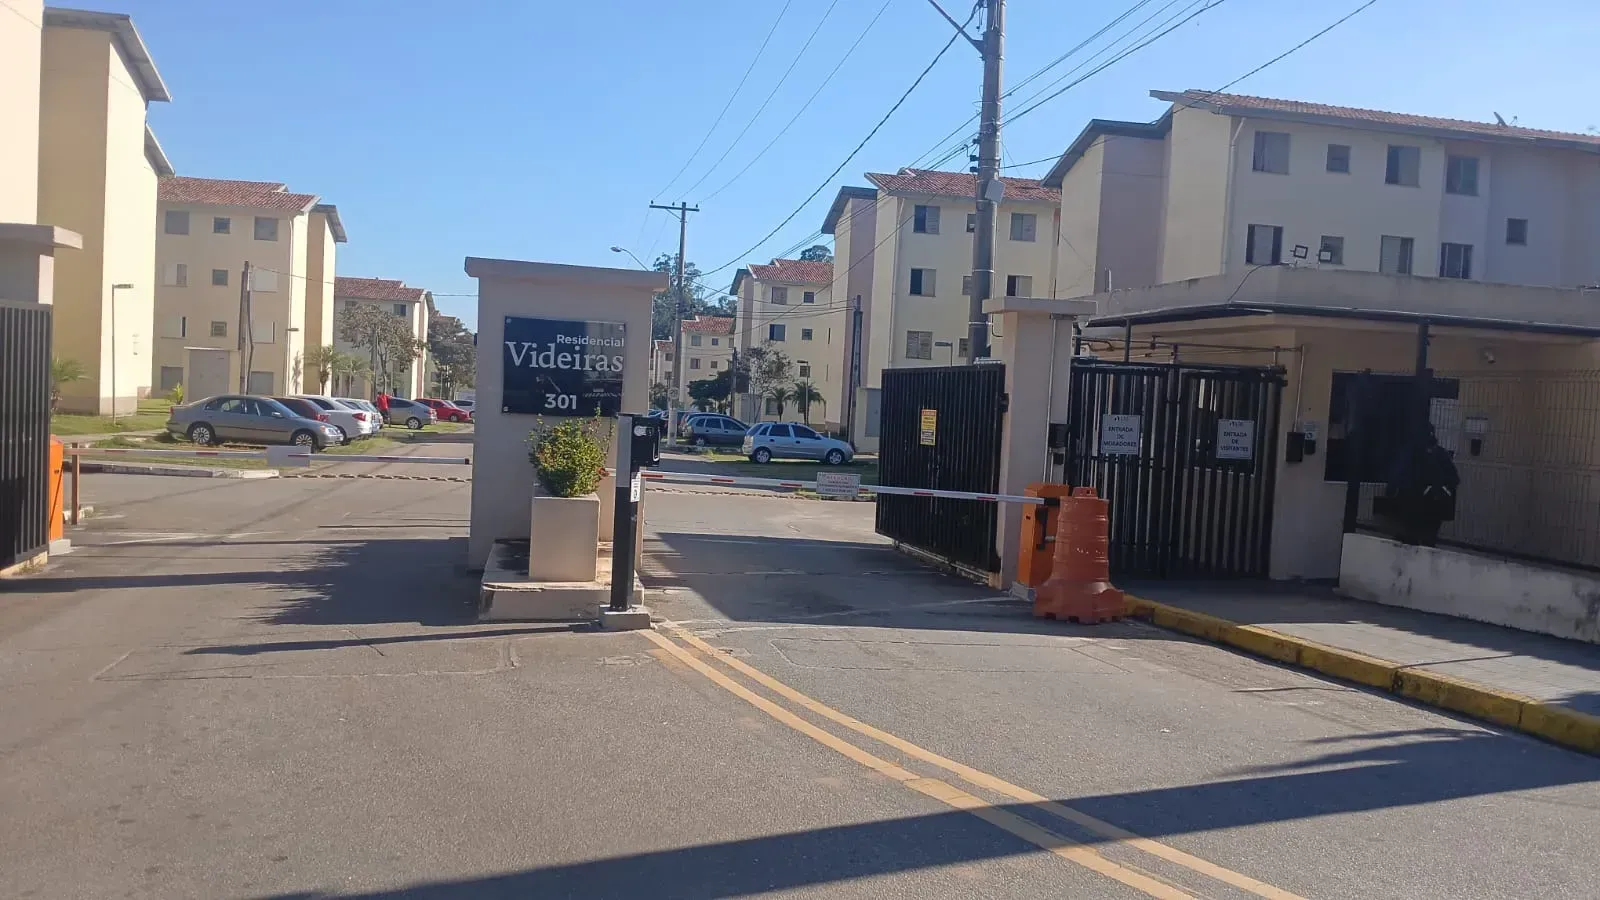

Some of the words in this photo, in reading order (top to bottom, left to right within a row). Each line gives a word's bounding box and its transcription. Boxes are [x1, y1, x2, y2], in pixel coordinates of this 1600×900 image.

[556, 334, 625, 347] Residencial
[504, 341, 624, 372] Videiras
[544, 393, 577, 410] 301
